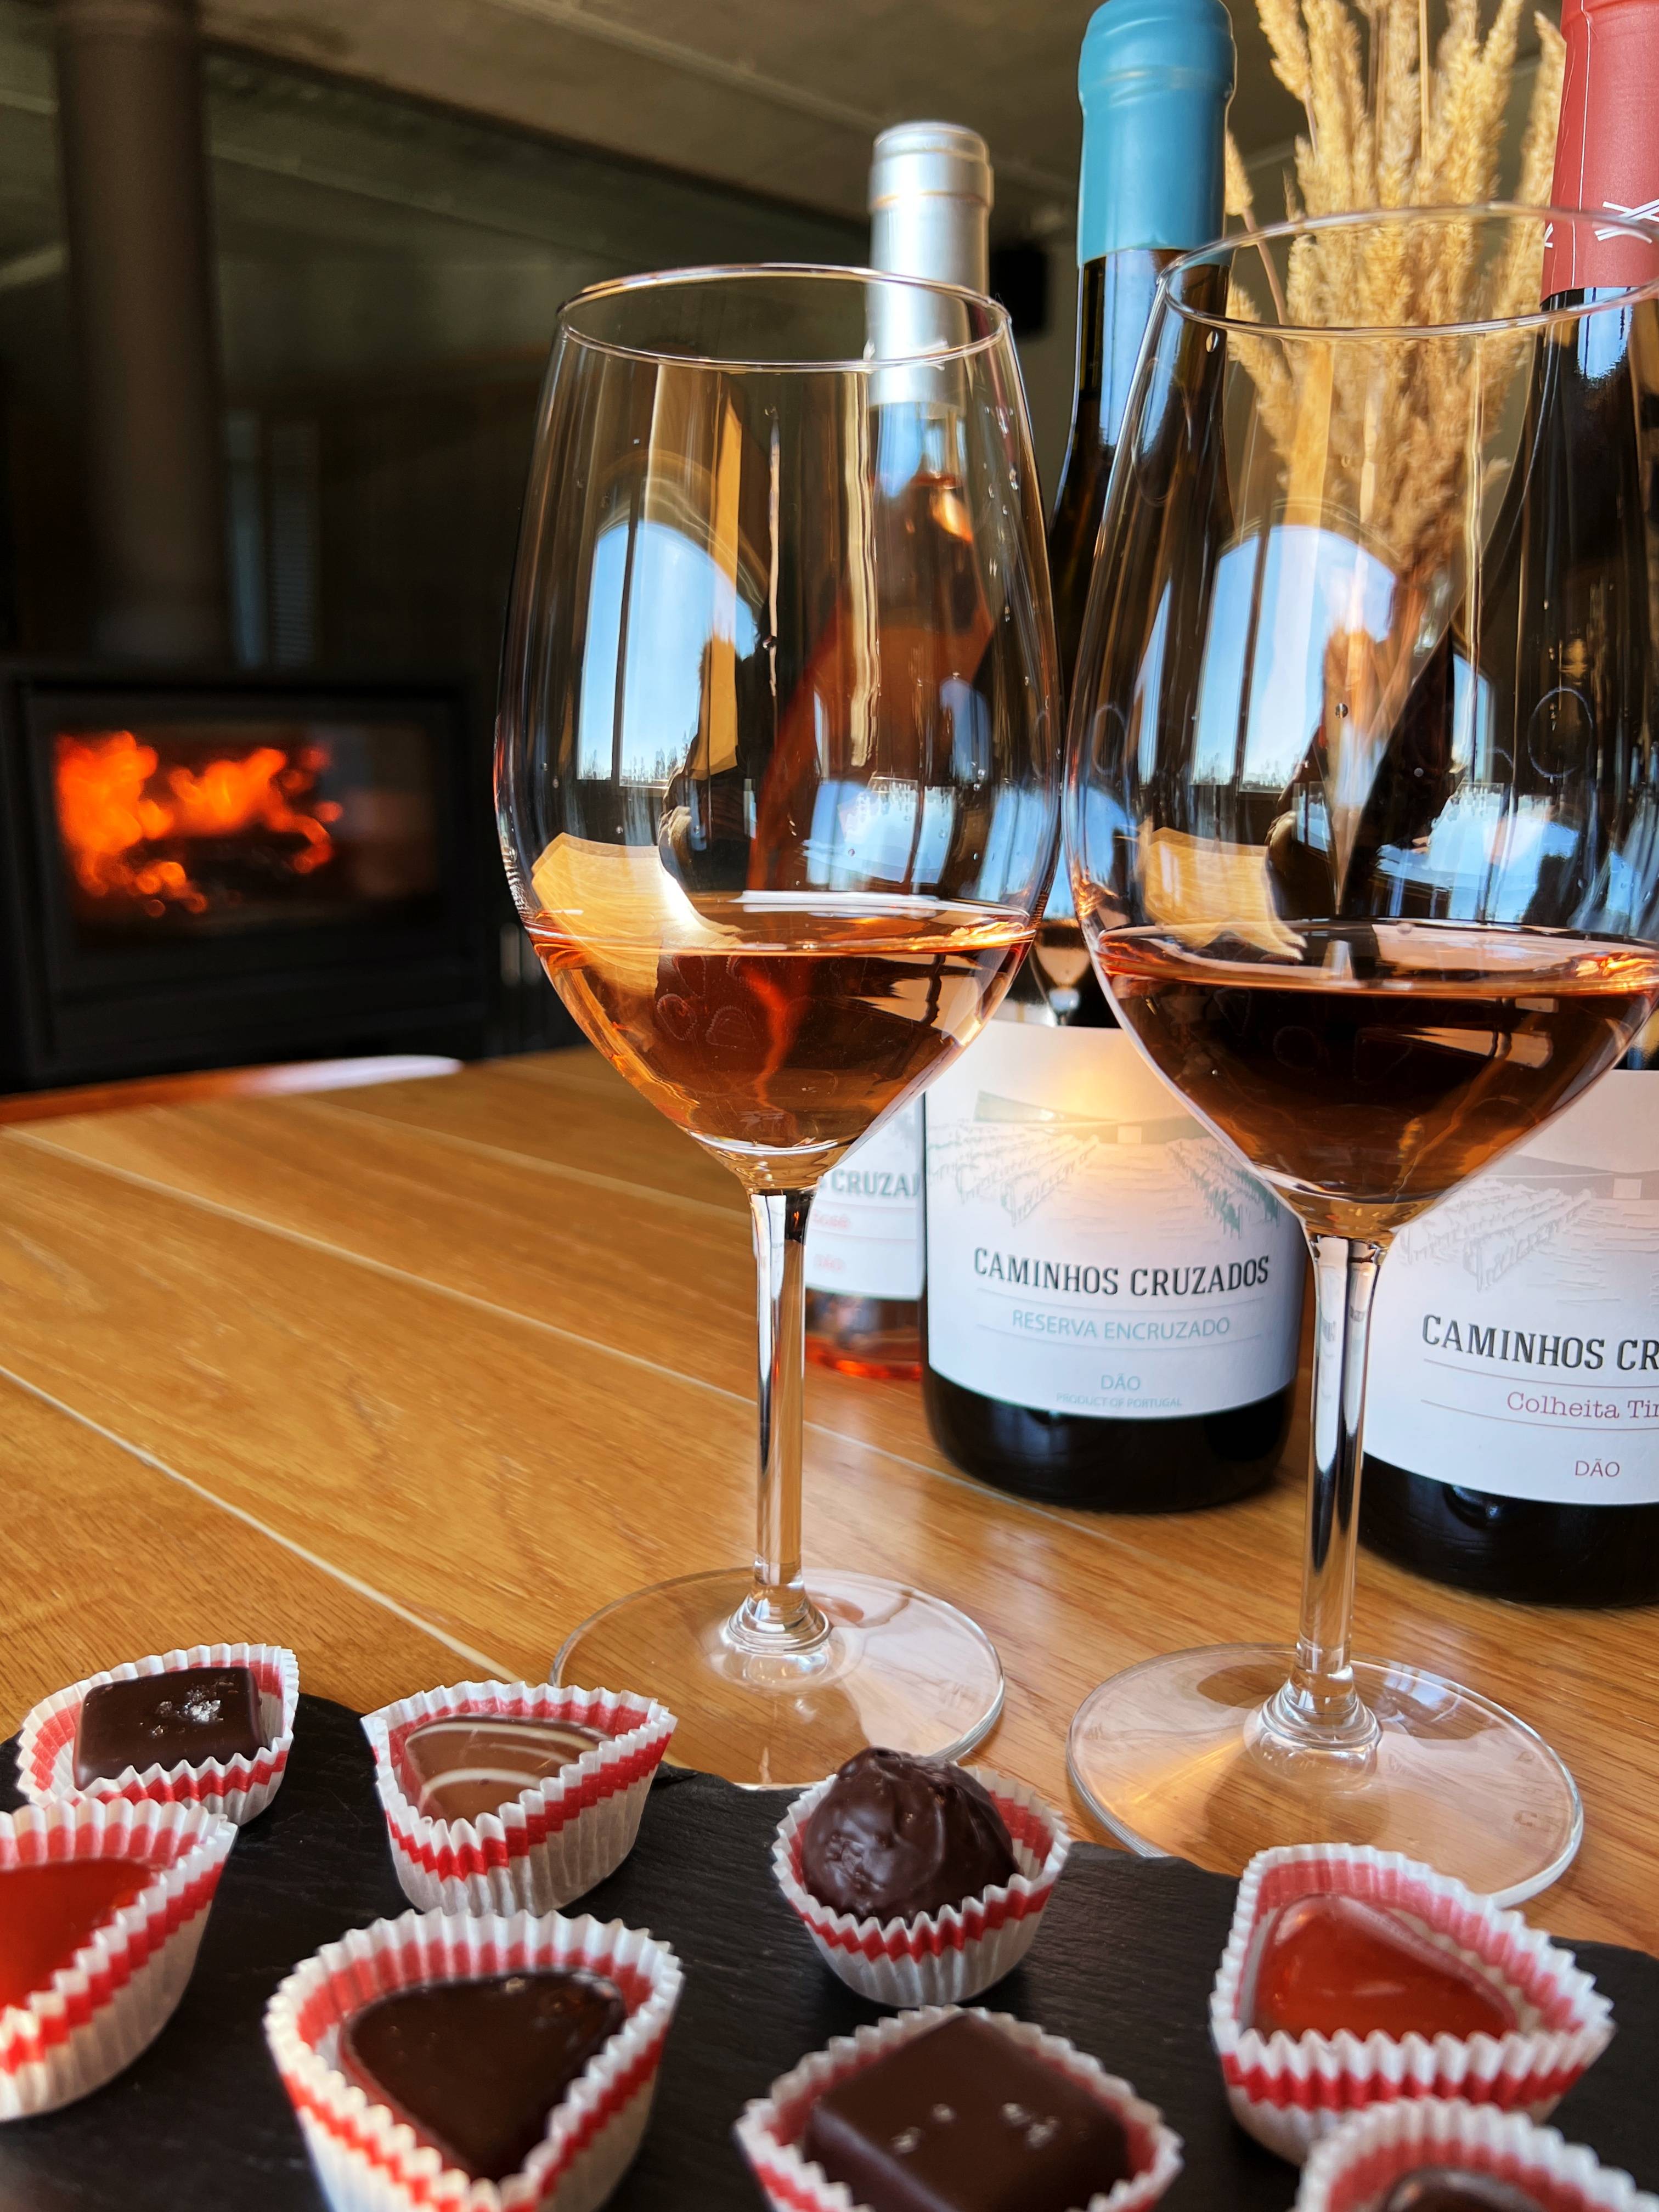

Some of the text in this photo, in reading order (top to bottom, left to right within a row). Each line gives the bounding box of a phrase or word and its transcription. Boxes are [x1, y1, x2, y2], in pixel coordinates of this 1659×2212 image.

[974, 1246, 1269, 1296] CAMINHOS CRUZADOS
[1012, 1308, 1231, 1340] RESERVA ENCRUZADO
[1422, 1313, 1659, 1370] CAMINHOS CR
[1100, 1373, 1142, 1391] DÃO
[1056, 1392, 1183, 1408] PRODUCT OF PORTUGAL
[1506, 1391, 1620, 1419] Colheita
[1575, 1458, 1620, 1477] DÃO
